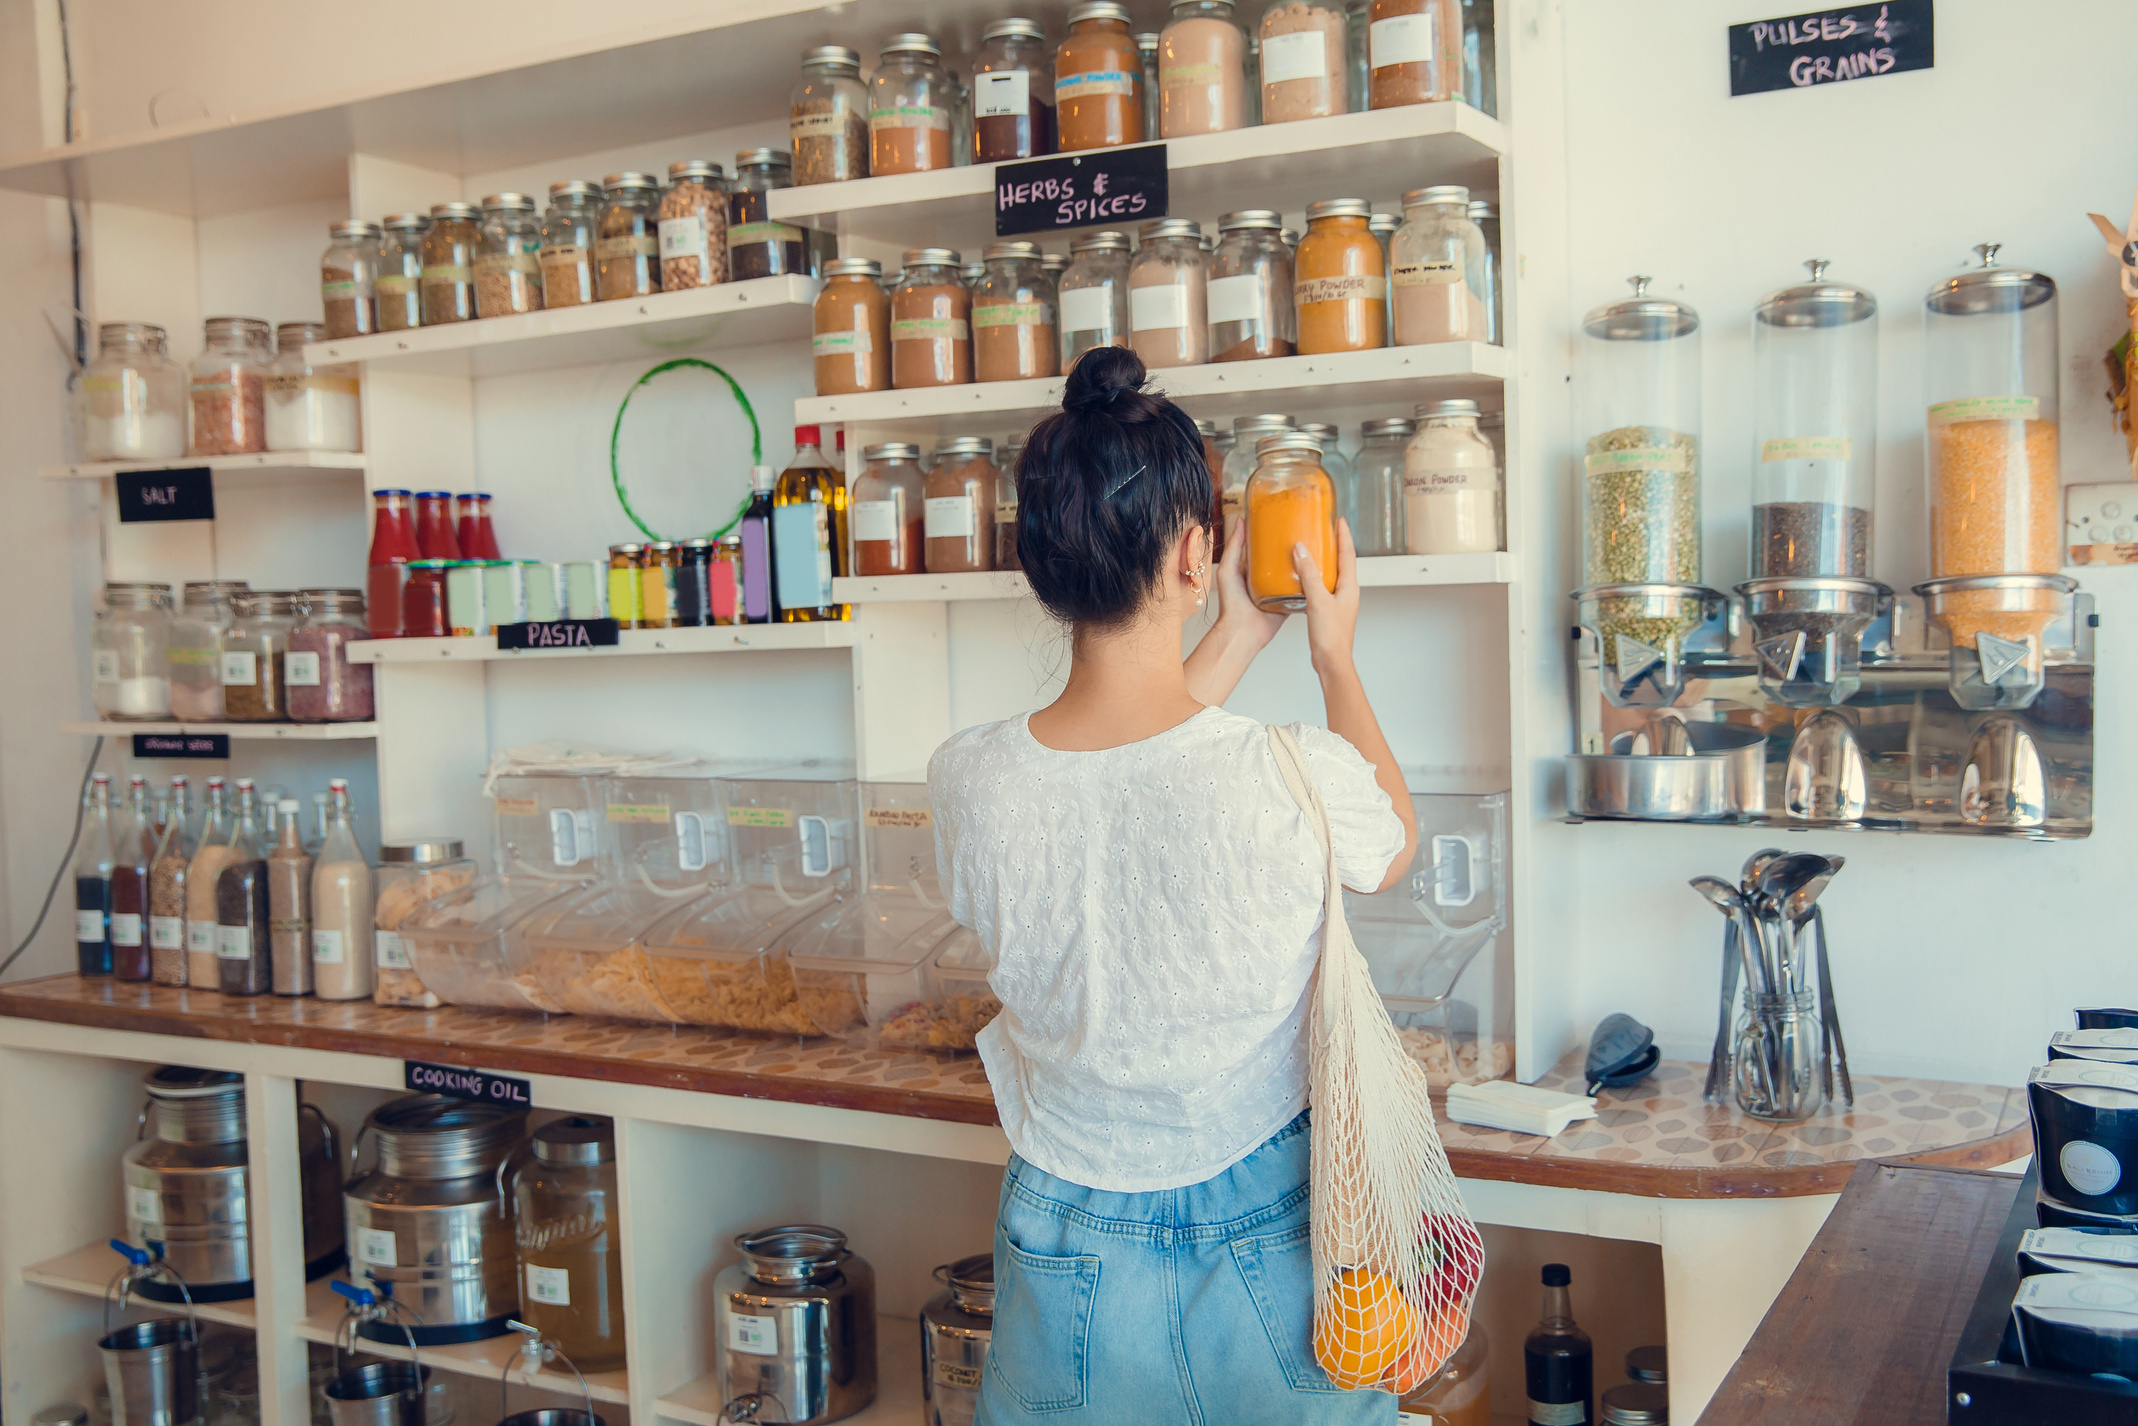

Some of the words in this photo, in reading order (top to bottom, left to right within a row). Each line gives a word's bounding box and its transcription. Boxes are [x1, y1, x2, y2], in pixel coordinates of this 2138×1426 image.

[1749, 14, 1856, 52] PULSES
[1790, 47, 1896, 87] GRAINS
[1000, 178, 1075, 211] HERBS
[1055, 192, 1147, 224] SPICES
[141, 485, 178, 505] SALT
[526, 622, 591, 647] PASTA
[411, 1066, 483, 1096] COOKING
[489, 1080, 529, 1102] OIL
